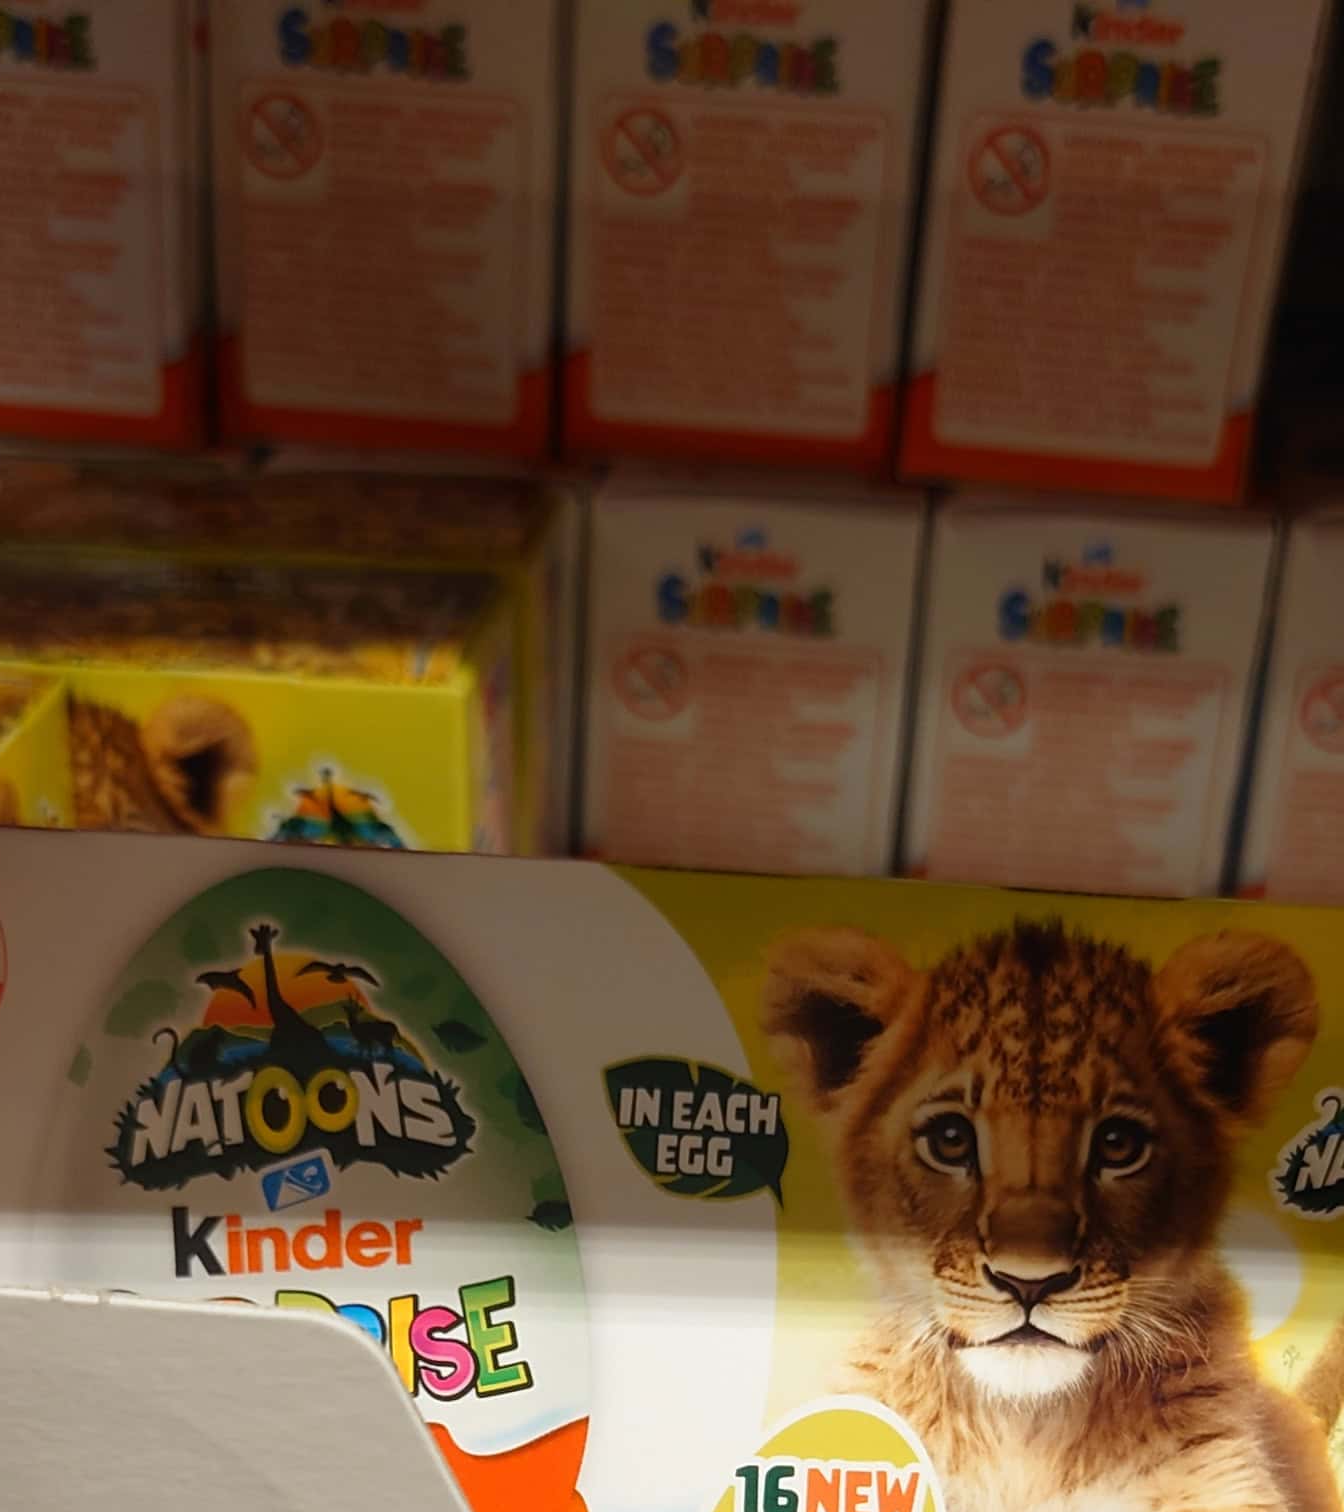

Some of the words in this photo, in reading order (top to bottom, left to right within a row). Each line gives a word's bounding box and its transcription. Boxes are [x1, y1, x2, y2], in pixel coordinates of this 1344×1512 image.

[130, 1061, 456, 1166] NATOONS
[618, 1087, 661, 1128] IN
[672, 1090, 779, 1136] EACH
[656, 1133, 734, 1177] EGG
[172, 1205, 424, 1279] Kinder
